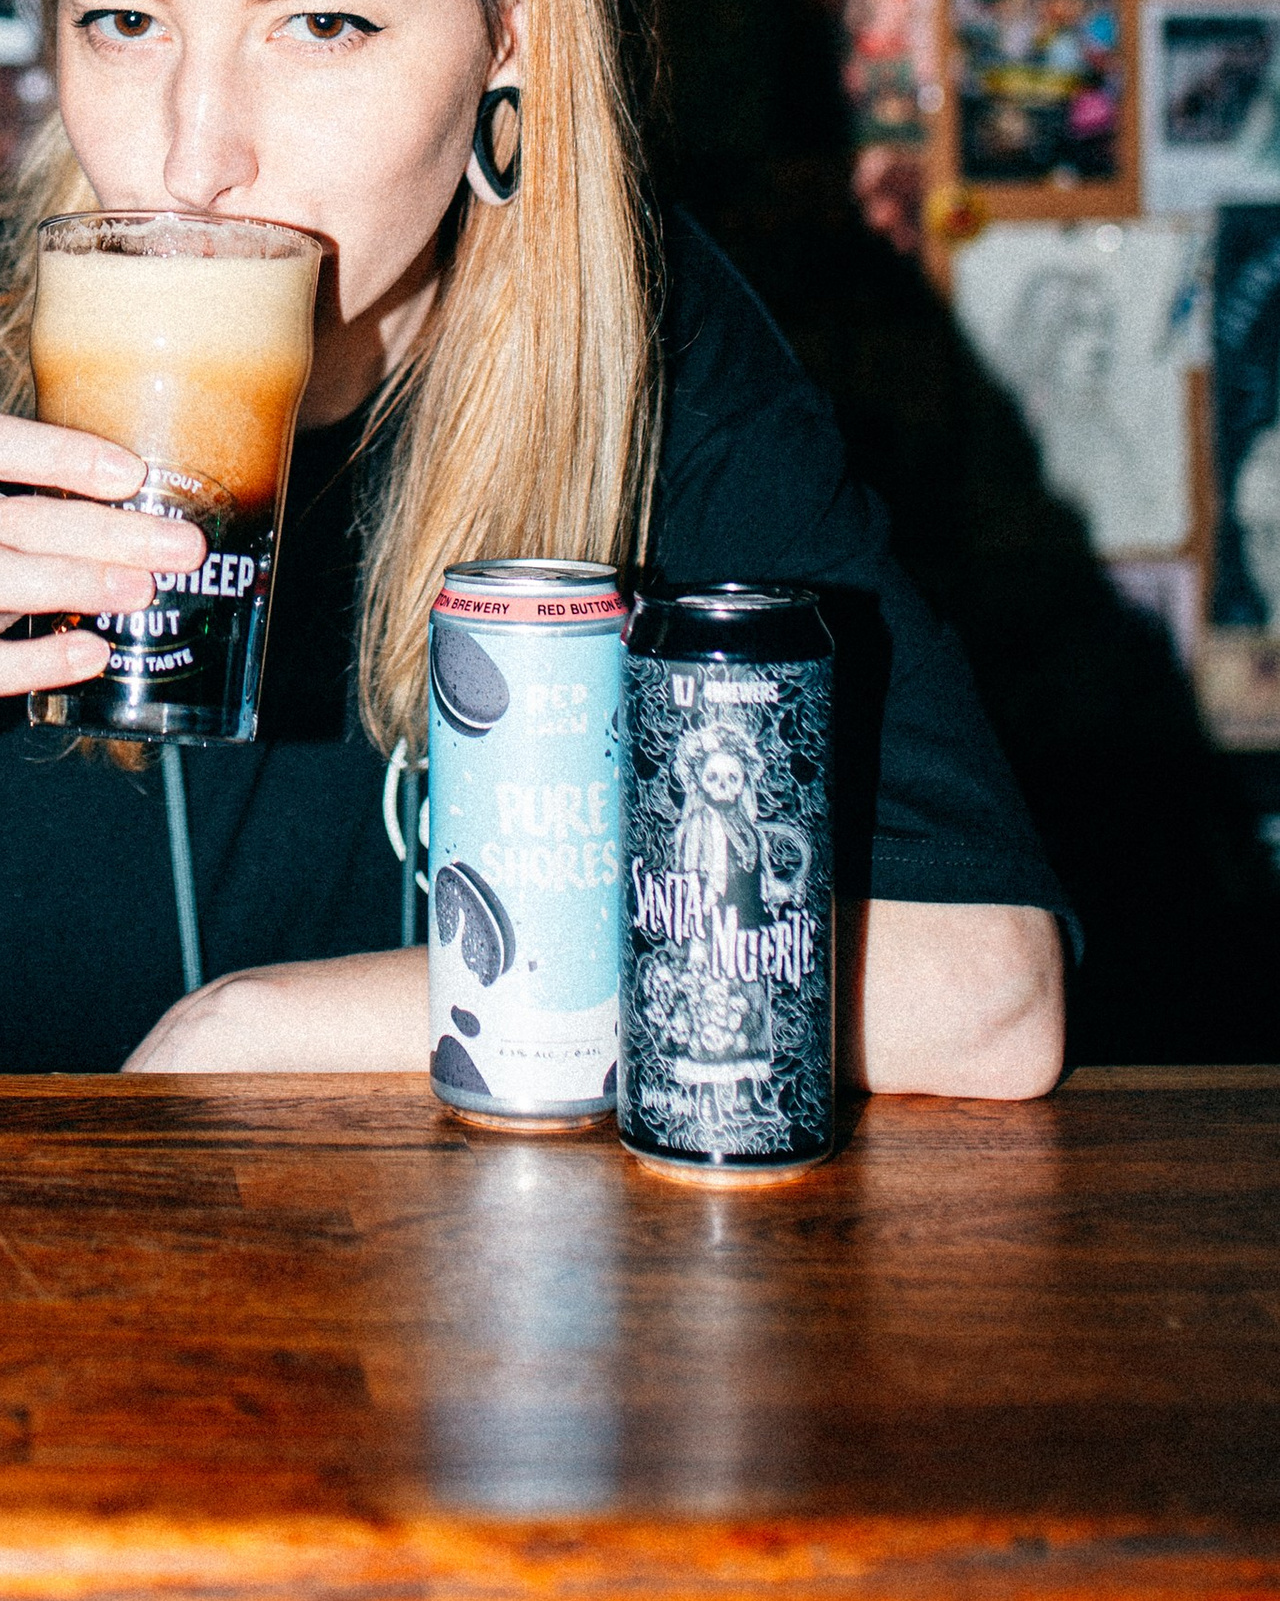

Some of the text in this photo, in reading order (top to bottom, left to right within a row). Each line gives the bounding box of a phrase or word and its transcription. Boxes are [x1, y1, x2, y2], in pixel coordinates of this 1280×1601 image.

[150, 468, 202, 493] STOUT
[451, 598, 510, 614] BREWERY
[537, 604, 565, 615] RED
[570, 600, 614, 614] BUTTON
[97, 610, 180, 636] STOUT
[110, 648, 193, 672] OTH TASTE
[494, 780, 610, 839] PURE
[480, 840, 618, 892] SHORES
